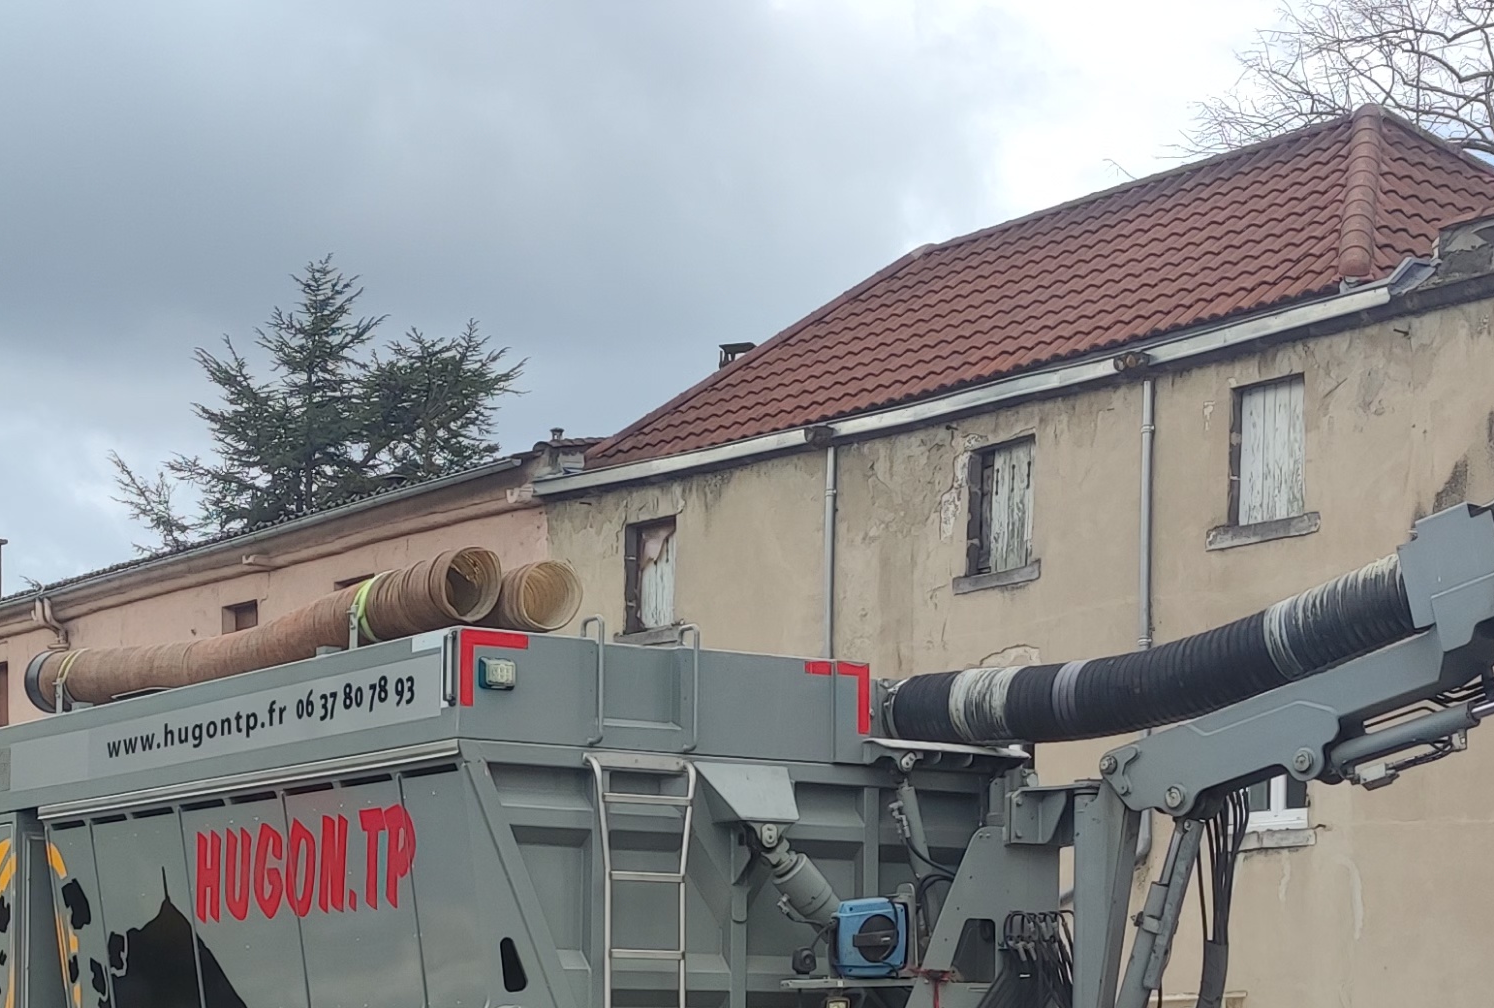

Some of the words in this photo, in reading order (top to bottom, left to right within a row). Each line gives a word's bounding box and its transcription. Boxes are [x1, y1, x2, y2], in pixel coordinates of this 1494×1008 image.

[107, 701, 286, 758] www.hugontp.fr
[296, 689, 314, 719] 06
[319, 691, 338, 721] 37
[343, 683, 363, 710] 80
[369, 675, 388, 712] 78
[395, 676, 414, 707] 93
[195, 804, 417, 924] HUGON.TP
